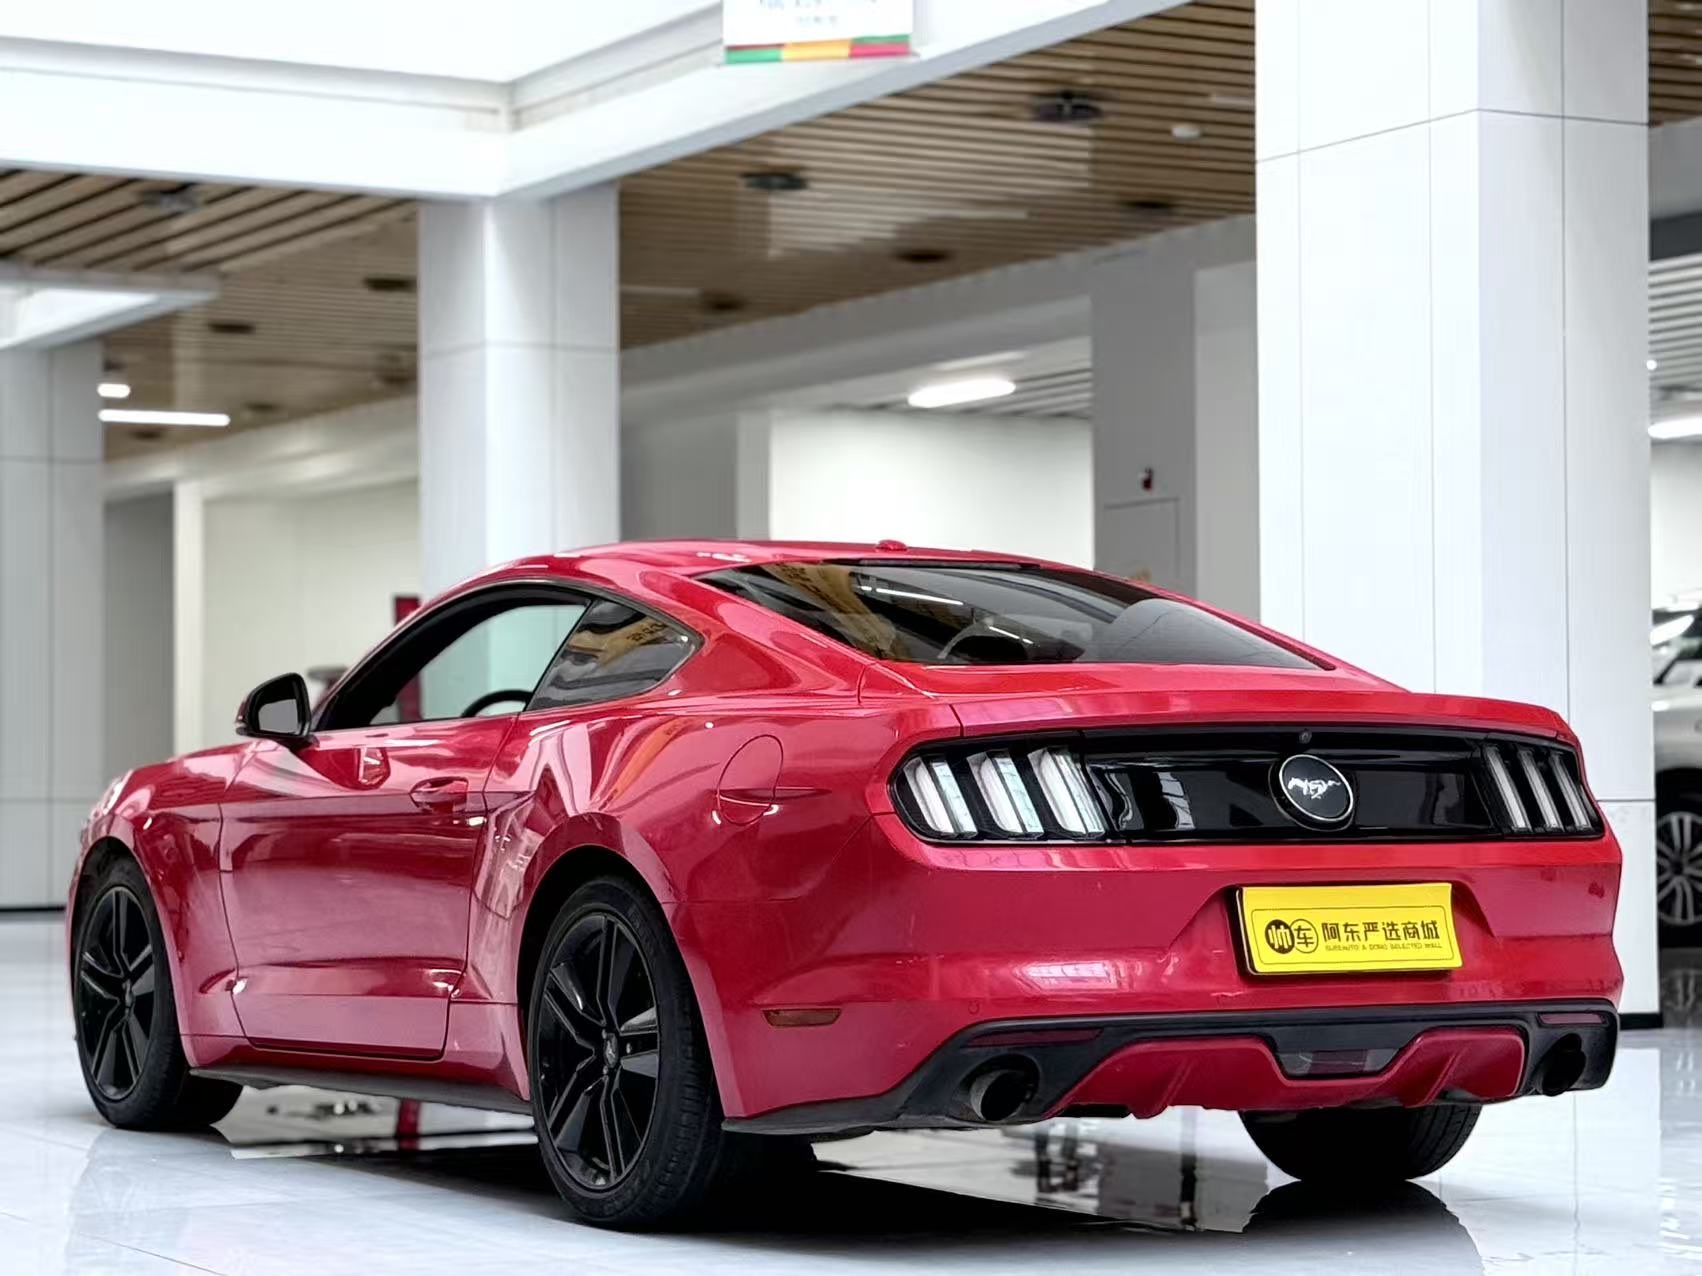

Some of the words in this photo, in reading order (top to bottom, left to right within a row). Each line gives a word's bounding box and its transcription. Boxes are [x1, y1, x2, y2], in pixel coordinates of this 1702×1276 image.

[1321, 920, 1440, 943] 阿东严选商城
